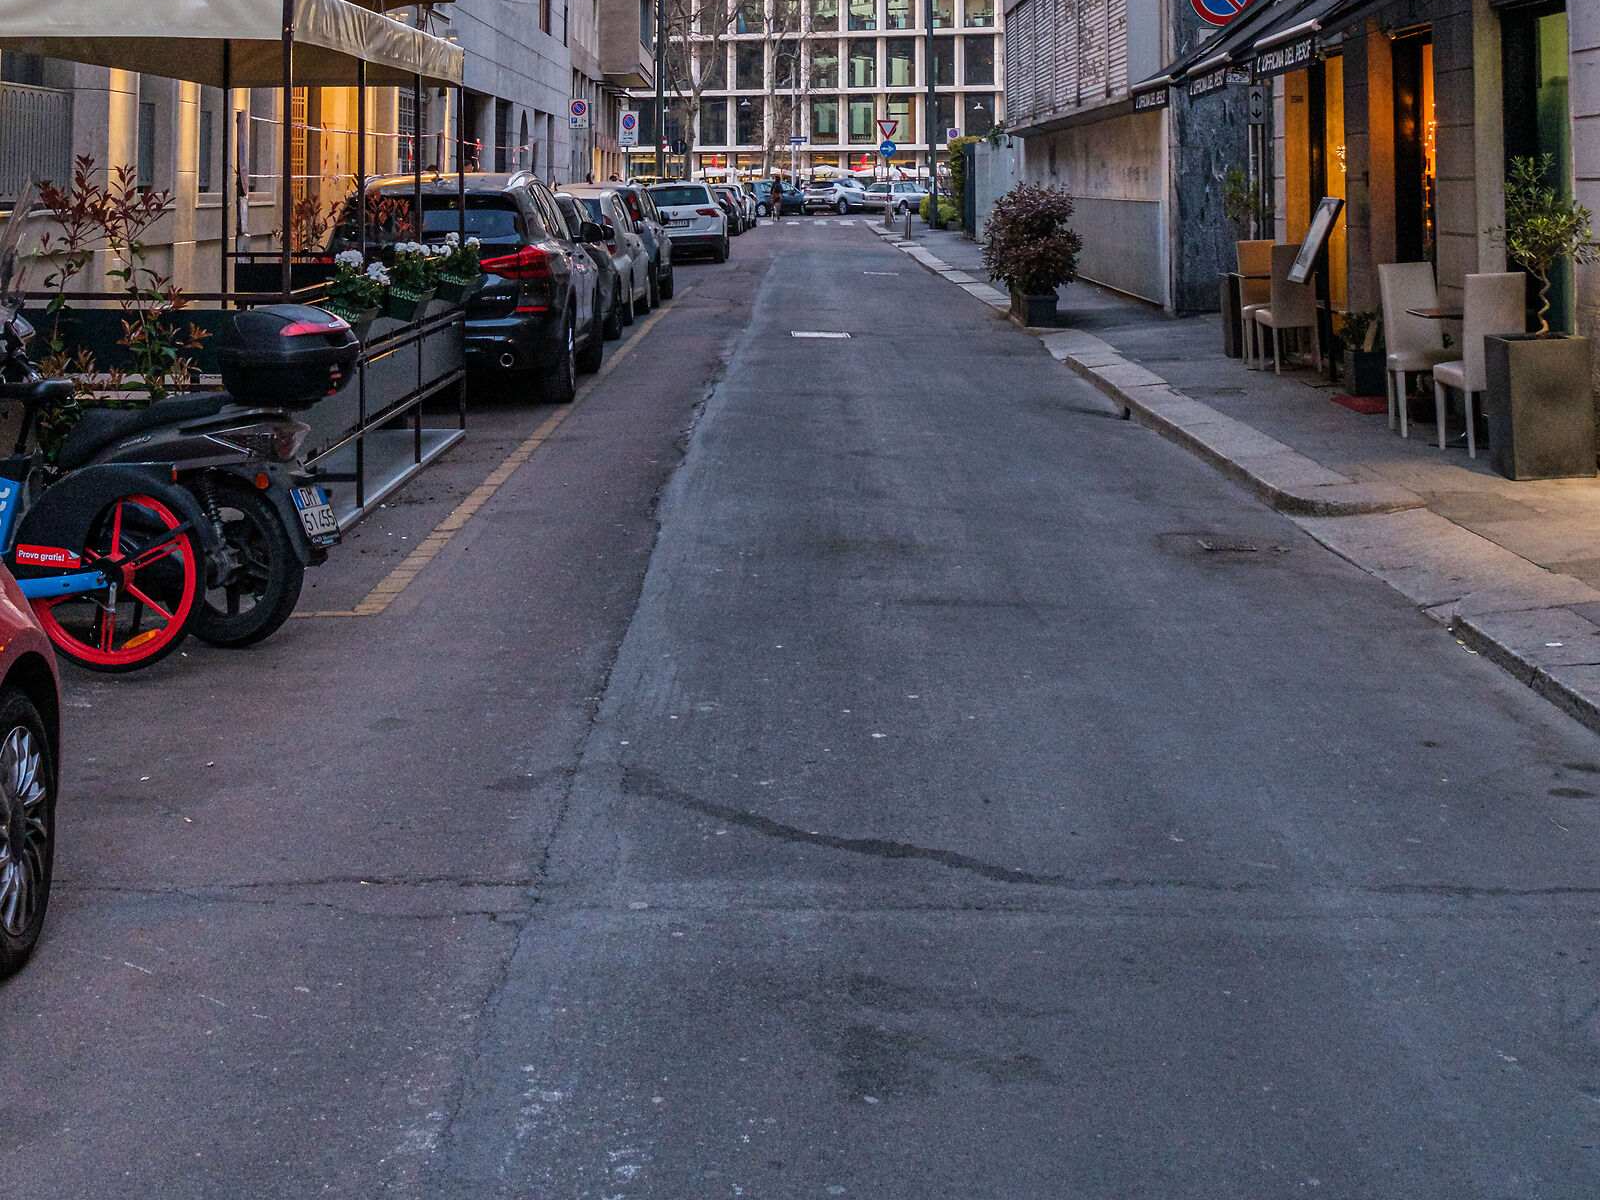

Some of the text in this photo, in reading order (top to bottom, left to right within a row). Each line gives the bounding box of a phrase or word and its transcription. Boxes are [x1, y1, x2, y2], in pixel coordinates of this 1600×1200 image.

[303, 508, 336, 531] 51455
[18, 549, 65, 562] Prova gratis!
